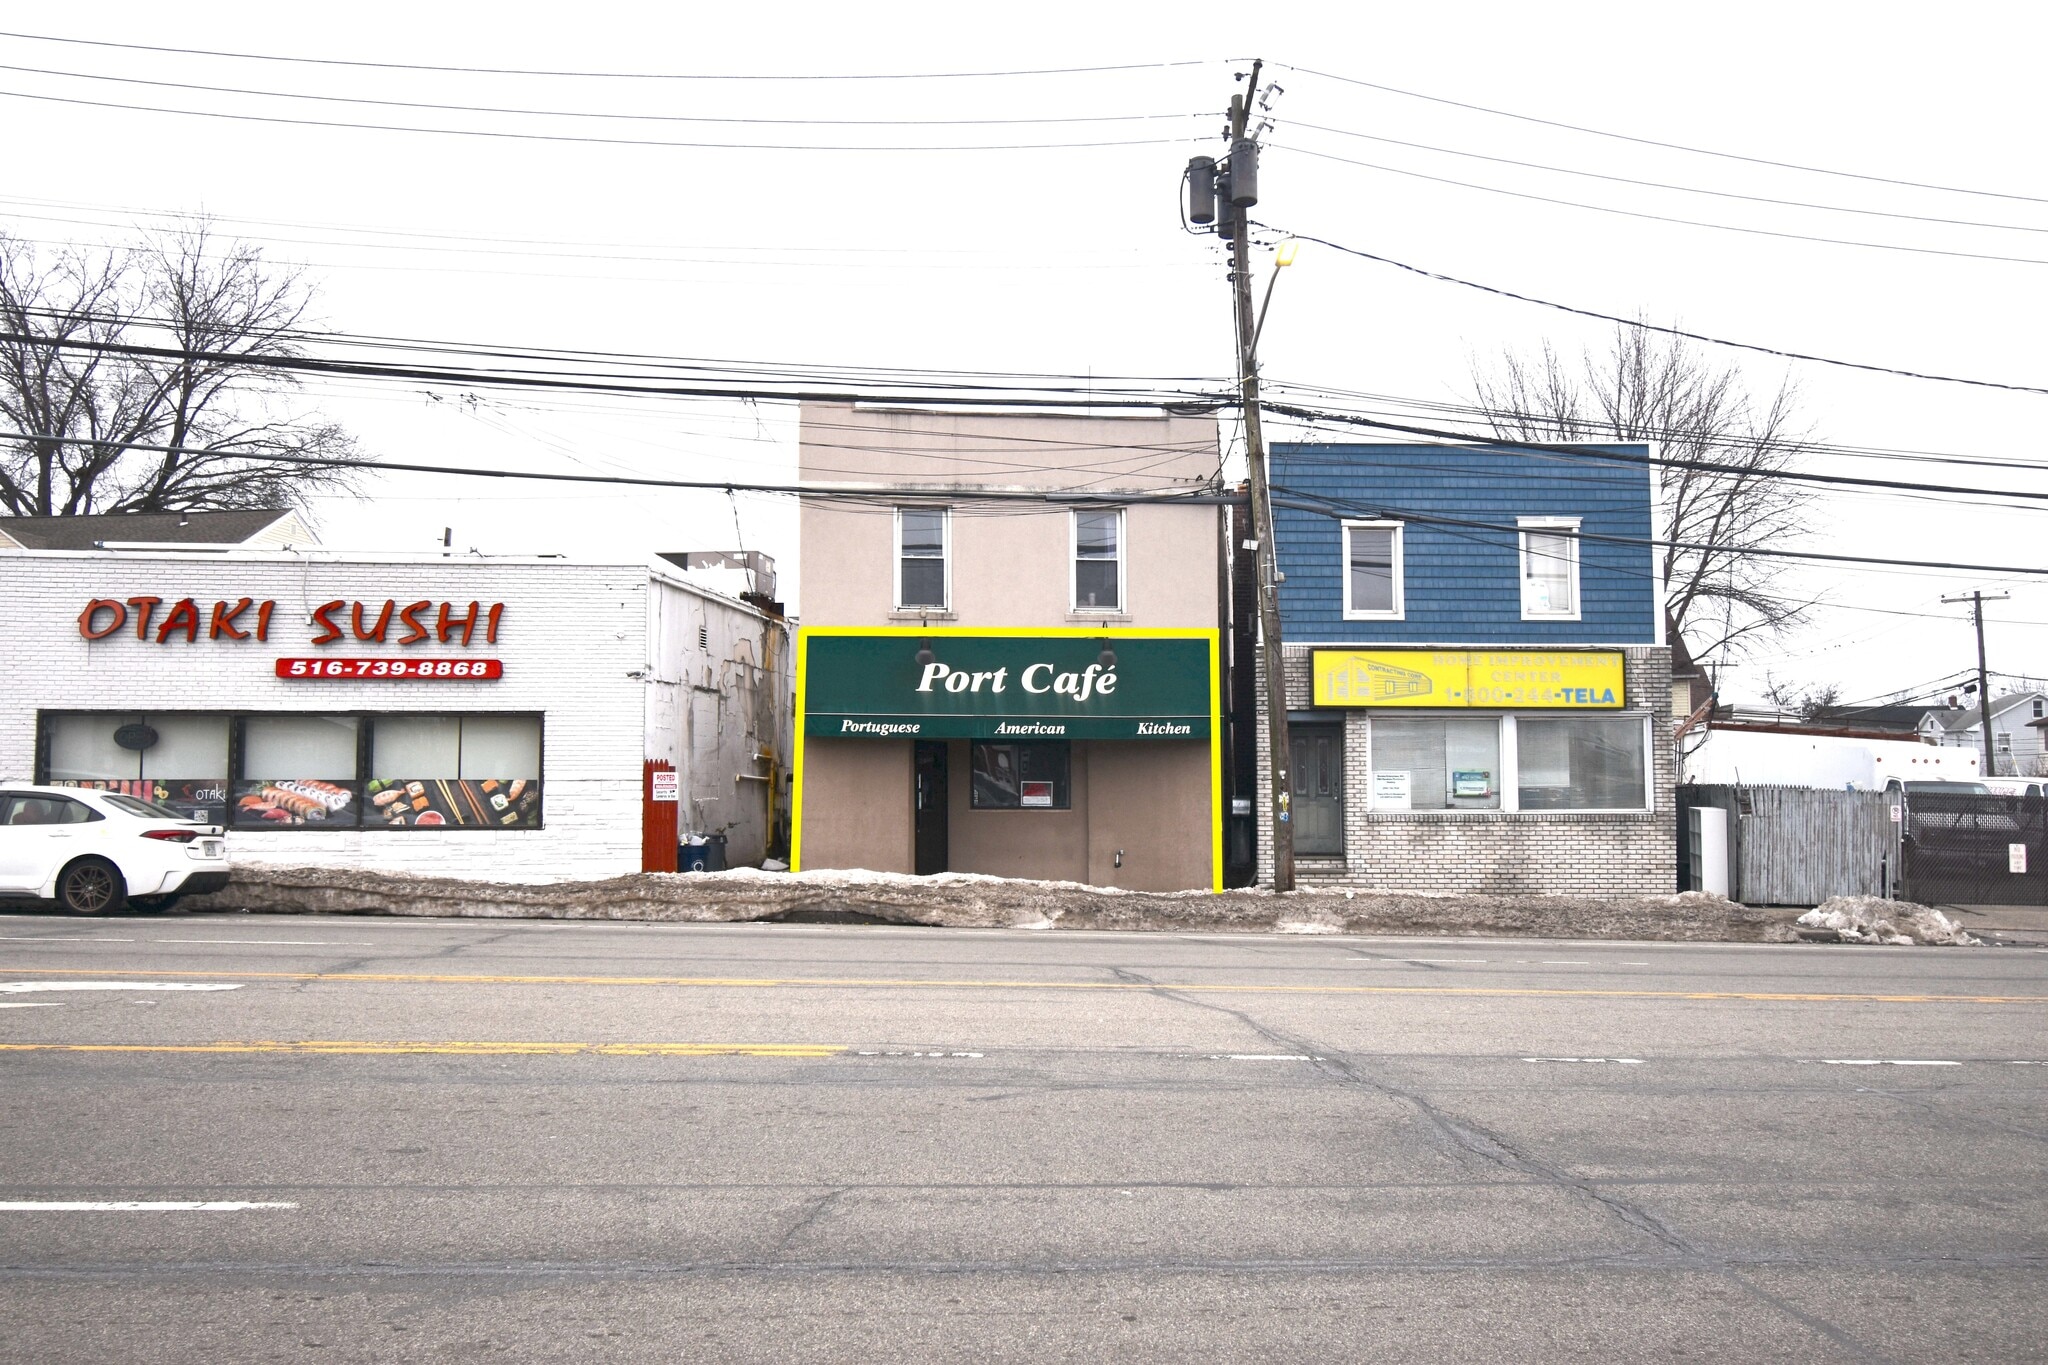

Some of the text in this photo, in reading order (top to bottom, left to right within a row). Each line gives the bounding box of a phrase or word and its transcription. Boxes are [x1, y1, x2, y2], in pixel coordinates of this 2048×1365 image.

[77, 596, 505, 647] OTAKI SUSHI
[290, 661, 488, 676] 516-739-8868
[1433, 655, 1619, 667] HOME IMPROVEMENT
[915, 662, 1118, 702] Port Café
[1491, 671, 1561, 683] CENTER
[1445, 687, 1616, 704] 1-800-244-TELA
[841, 719, 921, 736] Portuguese
[994, 721, 1066, 735] American
[1136, 722, 1191, 735] Kitchen
